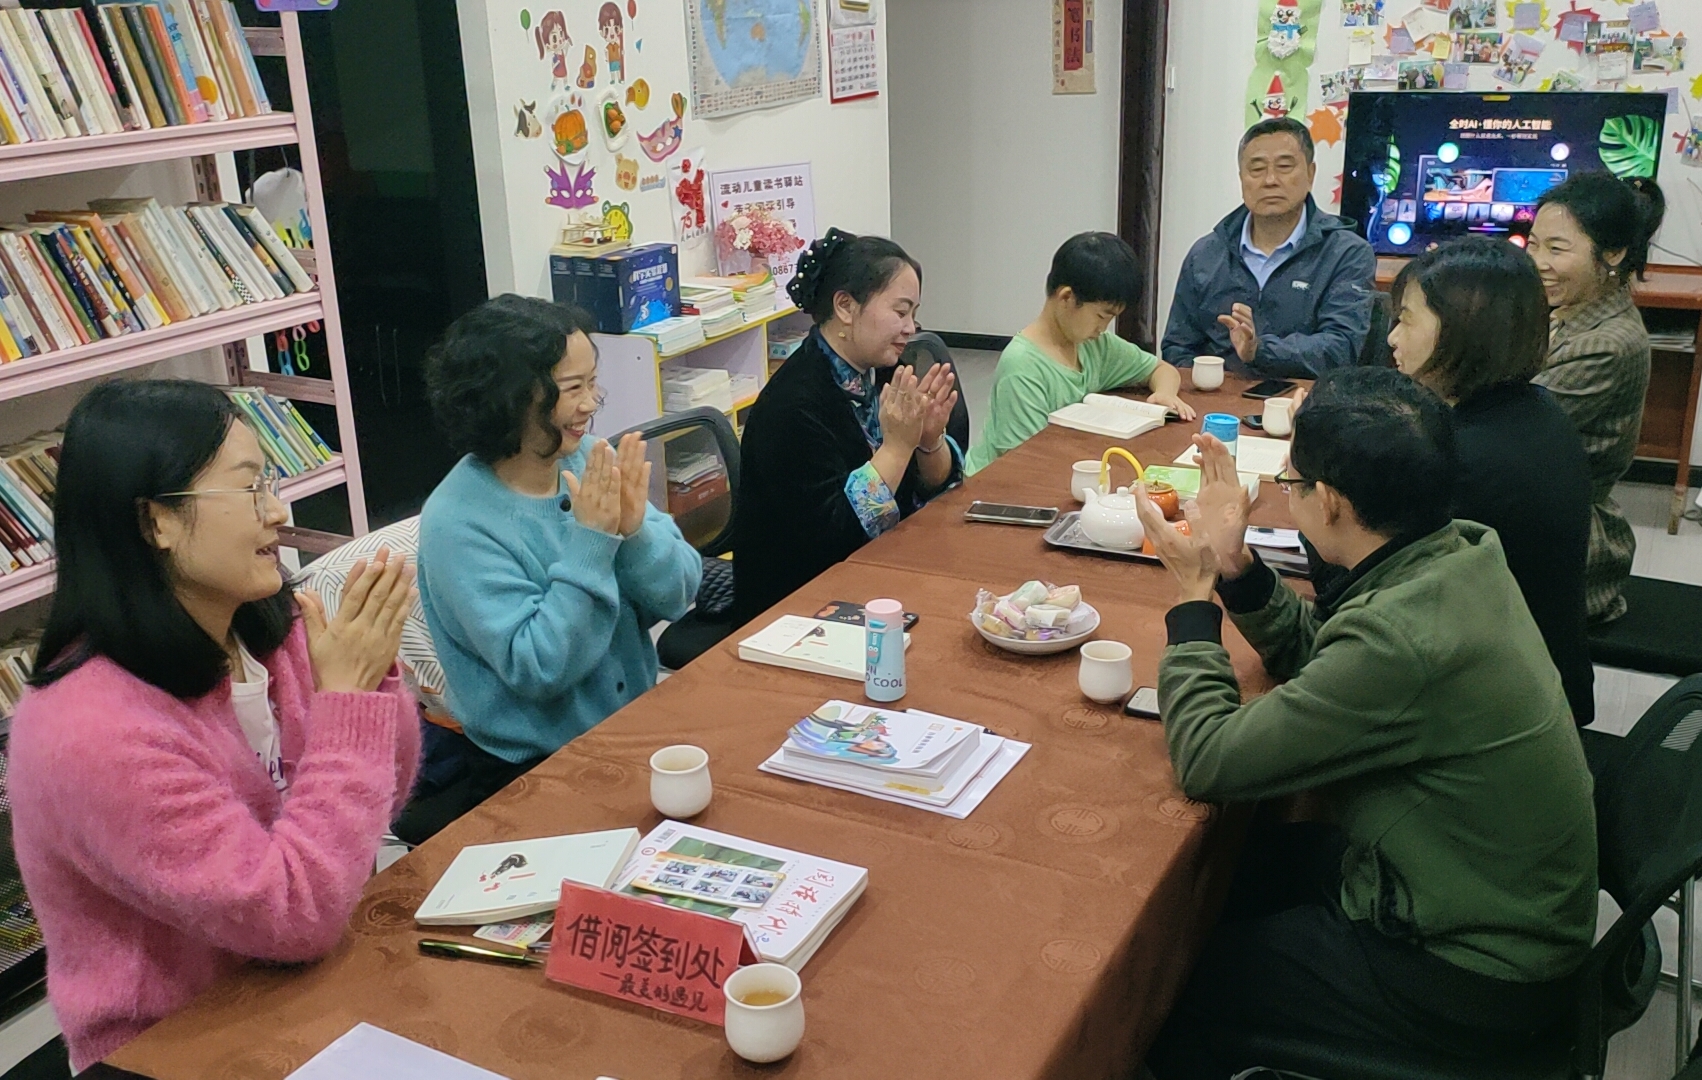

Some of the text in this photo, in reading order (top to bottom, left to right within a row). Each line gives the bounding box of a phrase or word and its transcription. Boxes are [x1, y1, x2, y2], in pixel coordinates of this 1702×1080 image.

[720, 175, 804, 195] 流动儿童读书驿站
[566, 912, 725, 990] 借阅签到处
